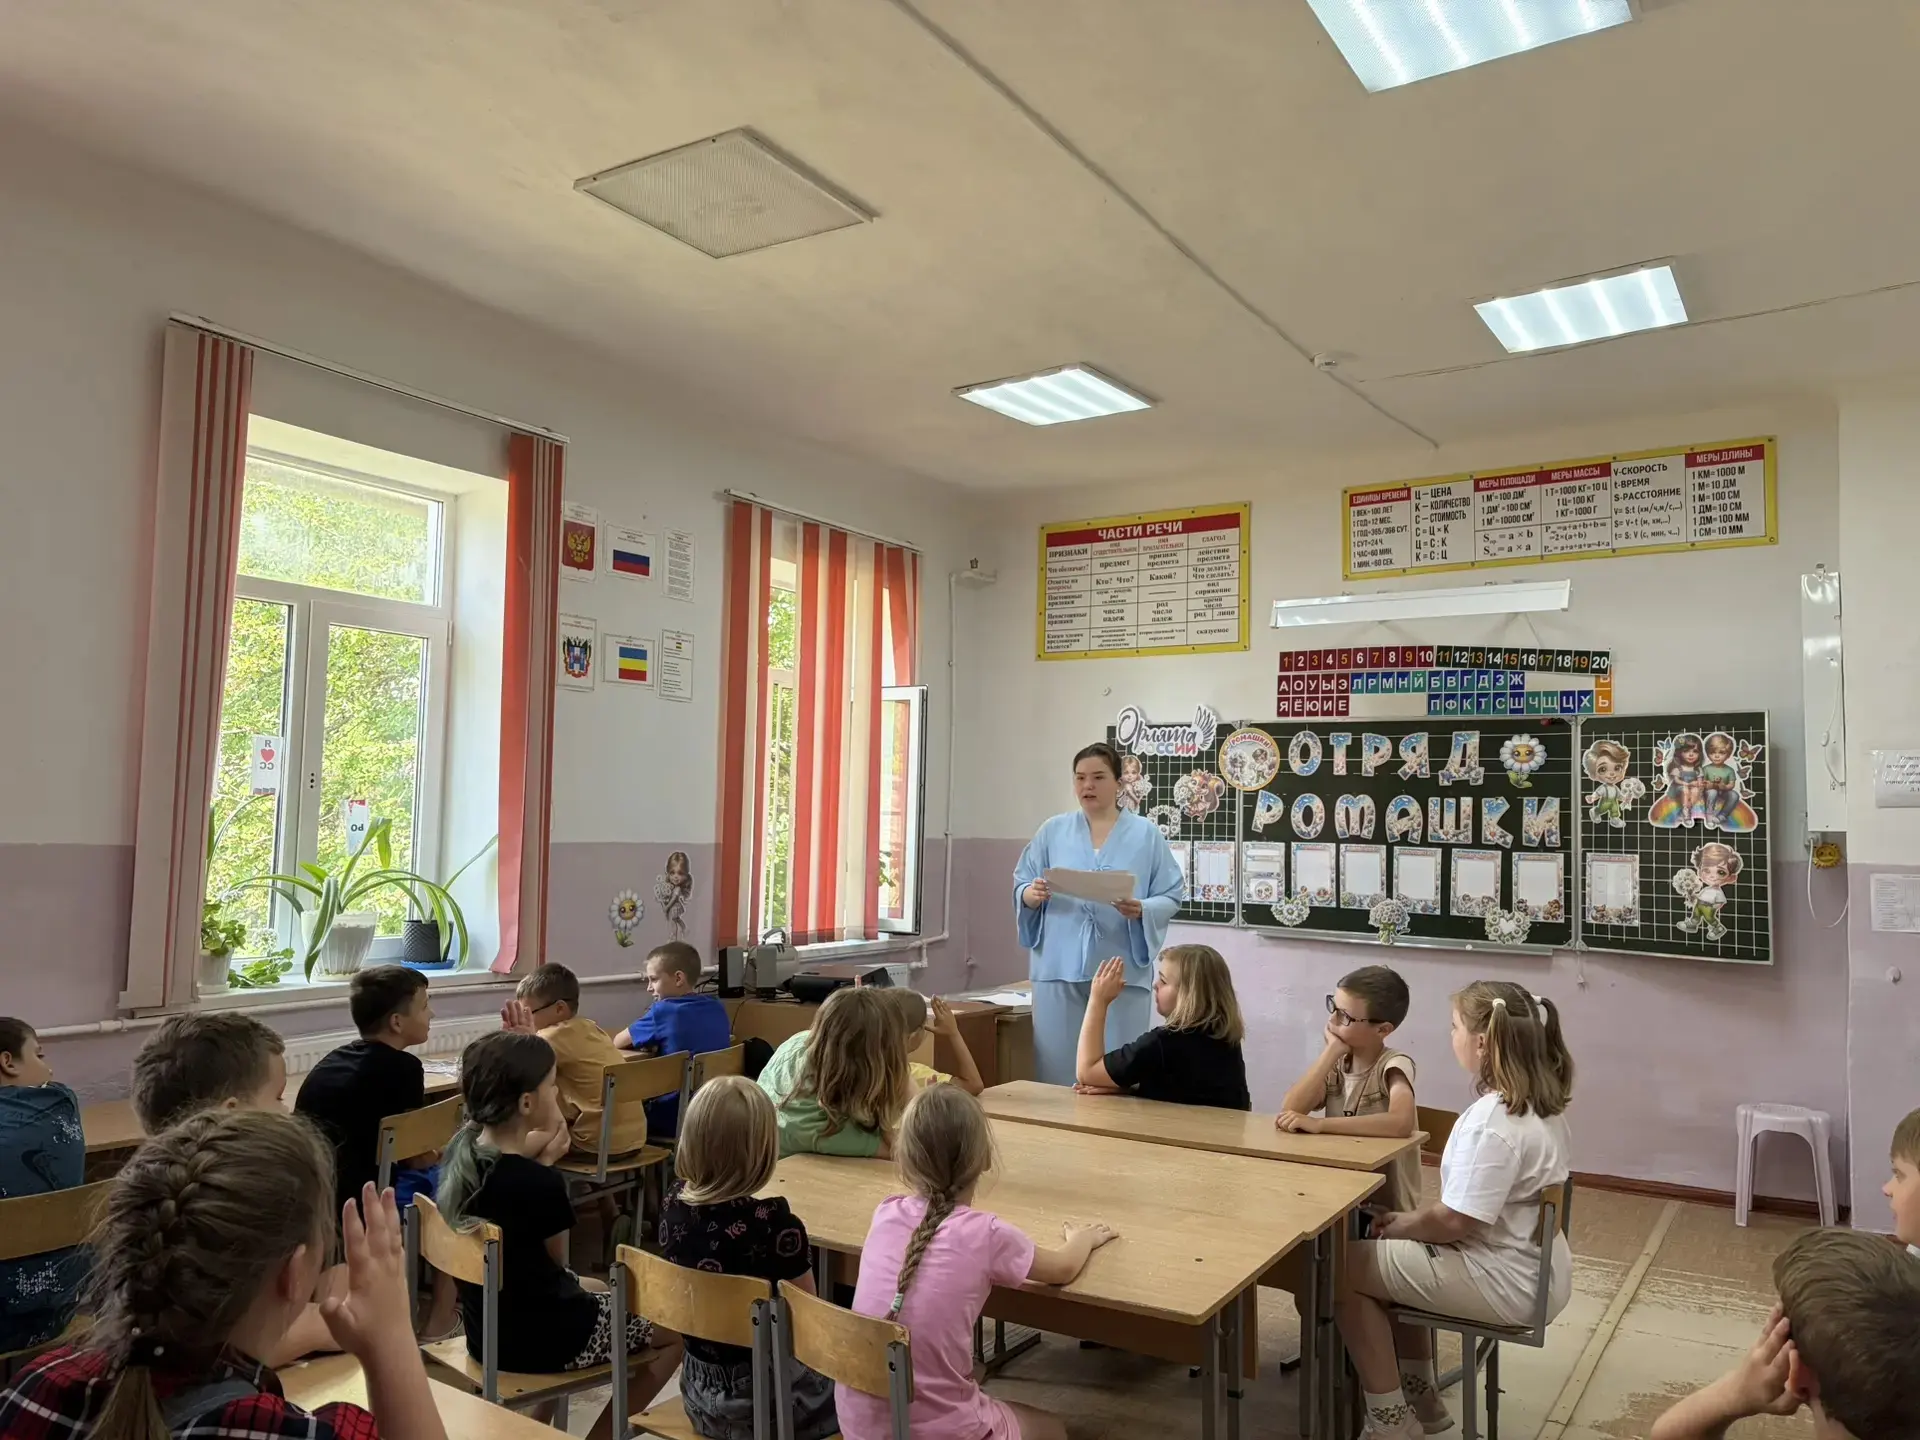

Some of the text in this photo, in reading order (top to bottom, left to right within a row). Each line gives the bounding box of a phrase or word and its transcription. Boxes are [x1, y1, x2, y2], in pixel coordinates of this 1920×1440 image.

[1697, 449, 1752, 463] МЕРЫ ДЛИНЫ
[1551, 466, 1600, 480] МЕРЫ МАССЫ
[1692, 471, 1695, 479] 1
[1738, 466, 1745, 474] М
[1479, 475, 1535, 488] МЕРЫ ПЛОЩАДИ
[1601, 482, 1607, 491] Ц
[1692, 483, 1695, 491] 1
[1722, 479, 1736, 489] ДМ
[1431, 487, 1452, 498] ЦЕНА
[1587, 495, 1595, 503] КГ
[1692, 494, 1695, 502] 1
[1728, 490, 1740, 499] СМ
[1431, 497, 1470, 510] КОЛИЧЕСТВО
[1693, 506, 1696, 514] 1
[1729, 502, 1741, 511] СМ
[1430, 510, 1466, 522] СТОИМОСТЬ
[1693, 517, 1696, 525] 1
[1735, 513, 1749, 522] ММ
[1098, 521, 1182, 540] ЧАСТИ РЕЧИ
[1694, 529, 1696, 537] 1
[1729, 525, 1743, 534] ММ
[1049, 548, 1087, 558] ПРИЗНАКИ
[1099, 559, 1130, 569] предмет
[1096, 576, 1134, 585] Кто? Что?
[1149, 572, 1176, 581] Какой?
[1284, 651, 1607, 668] 1 2 3 4 5 6 7 8 9 10 11 12 13 14 15 16 17 18 19 20
[1279, 674, 1523, 691] А О У Ы Э Л Р М Н Й Б В Г Д З Ж
[1279, 696, 1608, 711] Я Ё Ю И Е П Ф К Т С Ш Ч Щ Ц Х Ь
[1119, 707, 1196, 752] Орлята
[1232, 735, 1269, 748] РОМАШКИ
[1288, 730, 1484, 786] ОТРЯД
[1251, 790, 1561, 849] РОМАШКИ
[725, 1220, 747, 1239] YES
